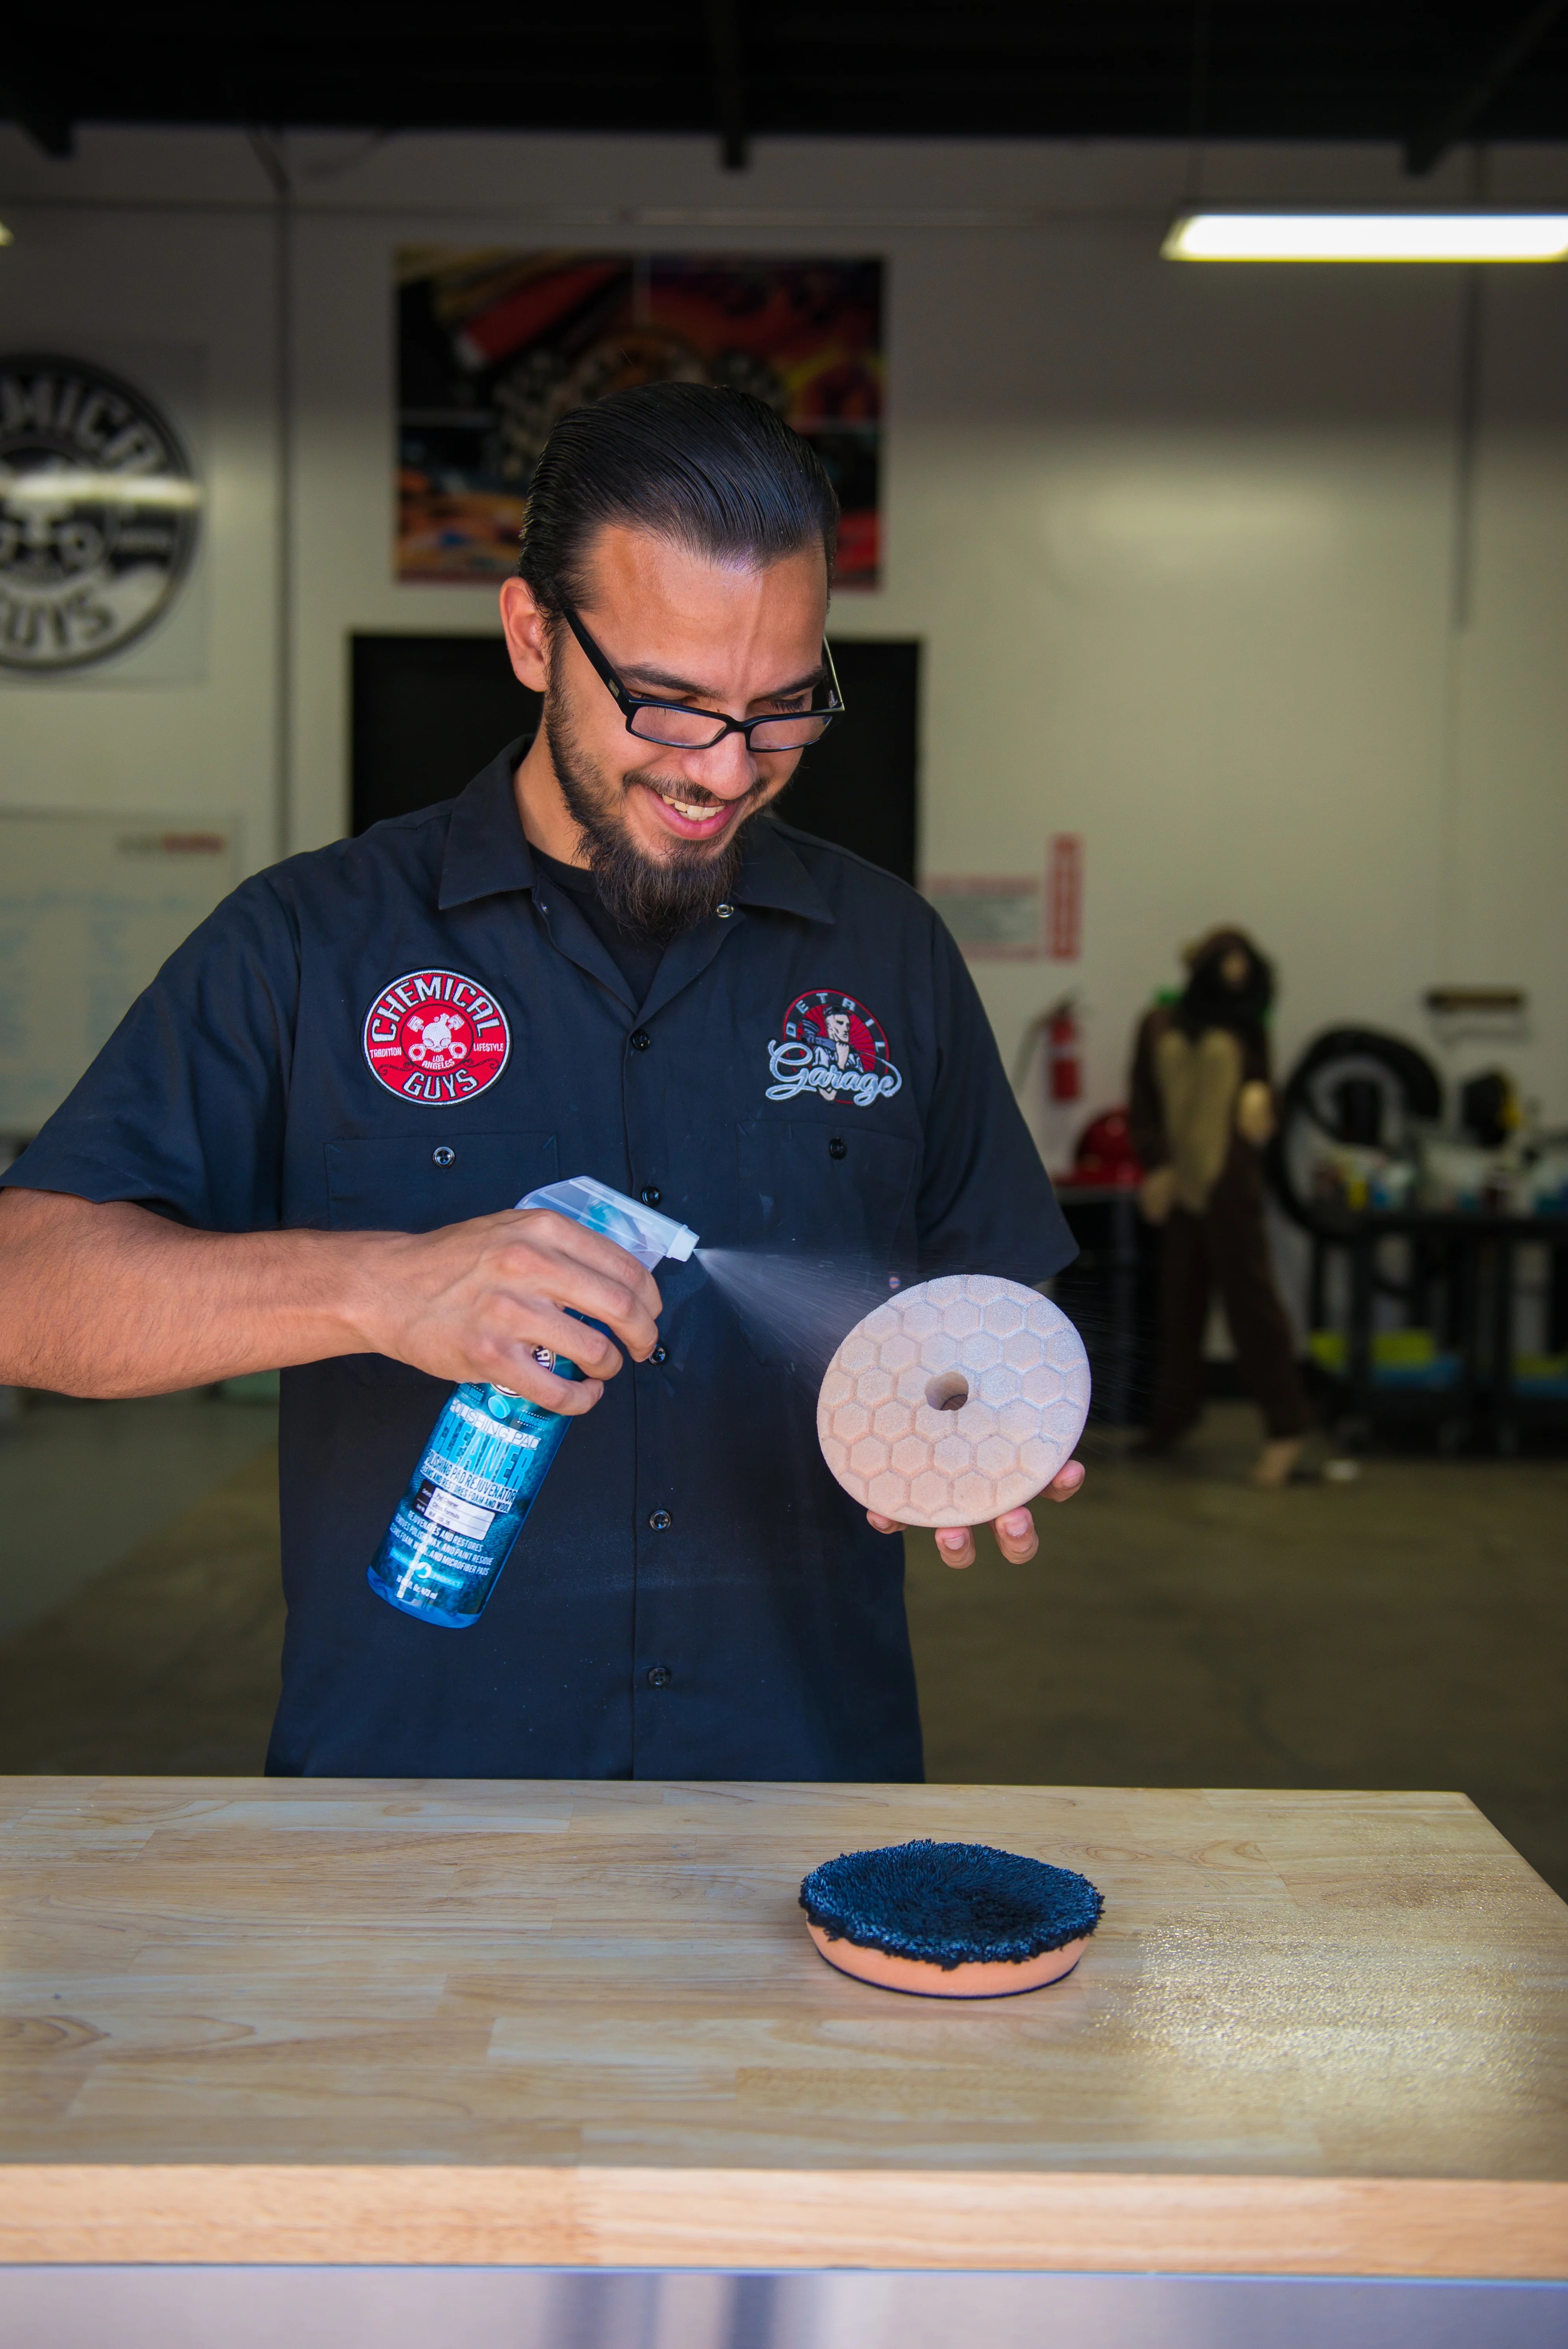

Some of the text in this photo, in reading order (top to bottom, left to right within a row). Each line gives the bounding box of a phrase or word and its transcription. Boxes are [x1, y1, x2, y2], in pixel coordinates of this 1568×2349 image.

[371, 976, 500, 1042] CHEMICAL
[786, 992, 885, 1052] DETAIL
[370, 1047, 402, 1058] TRADITION
[422, 1059, 455, 1069] ANGELES
[473, 1043, 504, 1052] LIFESTYLE
[402, 1069, 479, 1099] GUYS
[766, 1039, 902, 1106] Garage
[450, 1400, 539, 1449] POLISHING PAD
[432, 1410, 534, 1490] CLEANER
[433, 1473, 442, 1482] AND
[442, 1478, 468, 1496] RESTORES
[468, 1491, 484, 1502] FOAM
[485, 1498, 495, 1507] AND
[496, 1502, 509, 1511] WOOL
[452, 1468, 466, 1483] PAD
[465, 1475, 516, 1502] REJUVENATOR
[408, 1511, 482, 1552] REJUVENATES AND RESTORES
[429, 1551, 442, 1561] AND
[442, 1556, 476, 1573] MICROFIBER
[441, 1543, 455, 1554] AND
[454, 1549, 472, 1560] PAINT
[472, 1554, 493, 1565] RESIDUE
